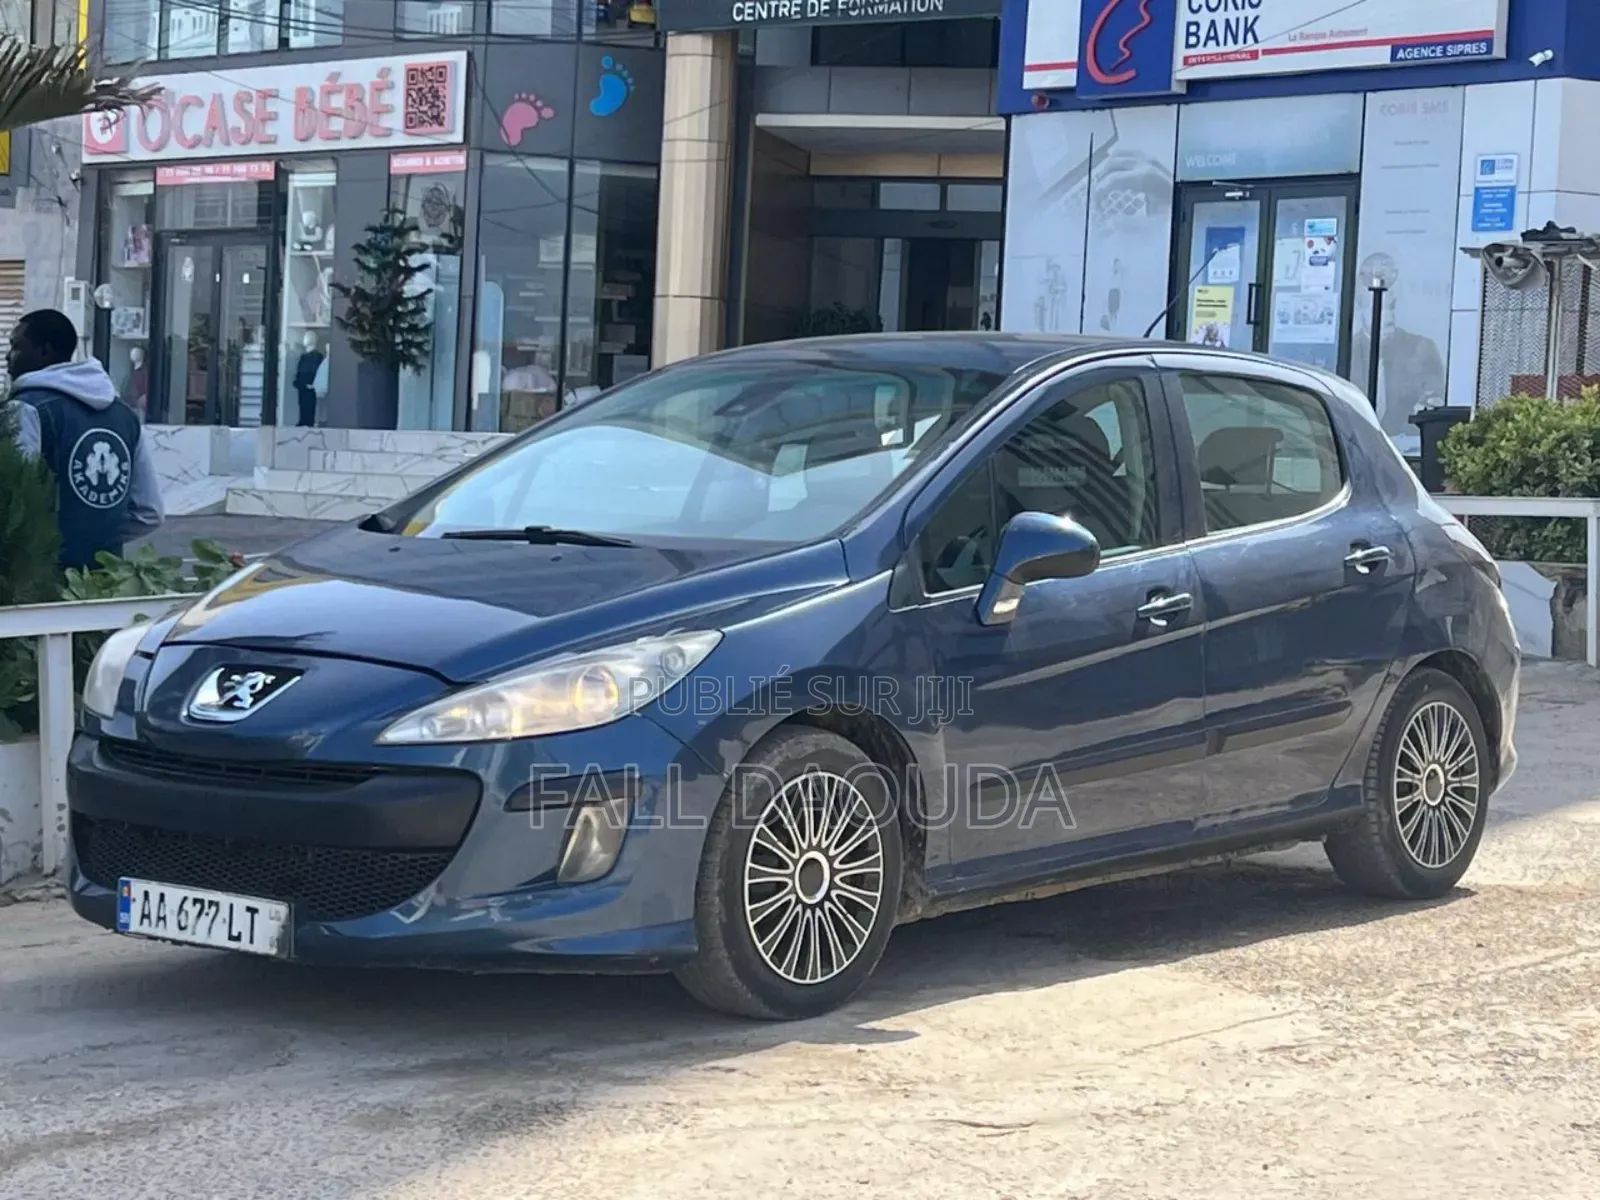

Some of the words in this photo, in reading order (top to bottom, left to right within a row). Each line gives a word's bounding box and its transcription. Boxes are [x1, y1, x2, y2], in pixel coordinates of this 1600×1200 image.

[732, 1, 801, 22] CENTRE
[806, 0, 830, 17] DE
[1185, 15, 1260, 49] BANK
[1396, 46, 1443, 60] AGENCE
[1446, 42, 1487, 56] SIPRES
[294, 68, 395, 142] BÉBÉ
[139, 890, 168, 930] AA
[176, 896, 220, 937] 677
[227, 903, 260, 945] LT
